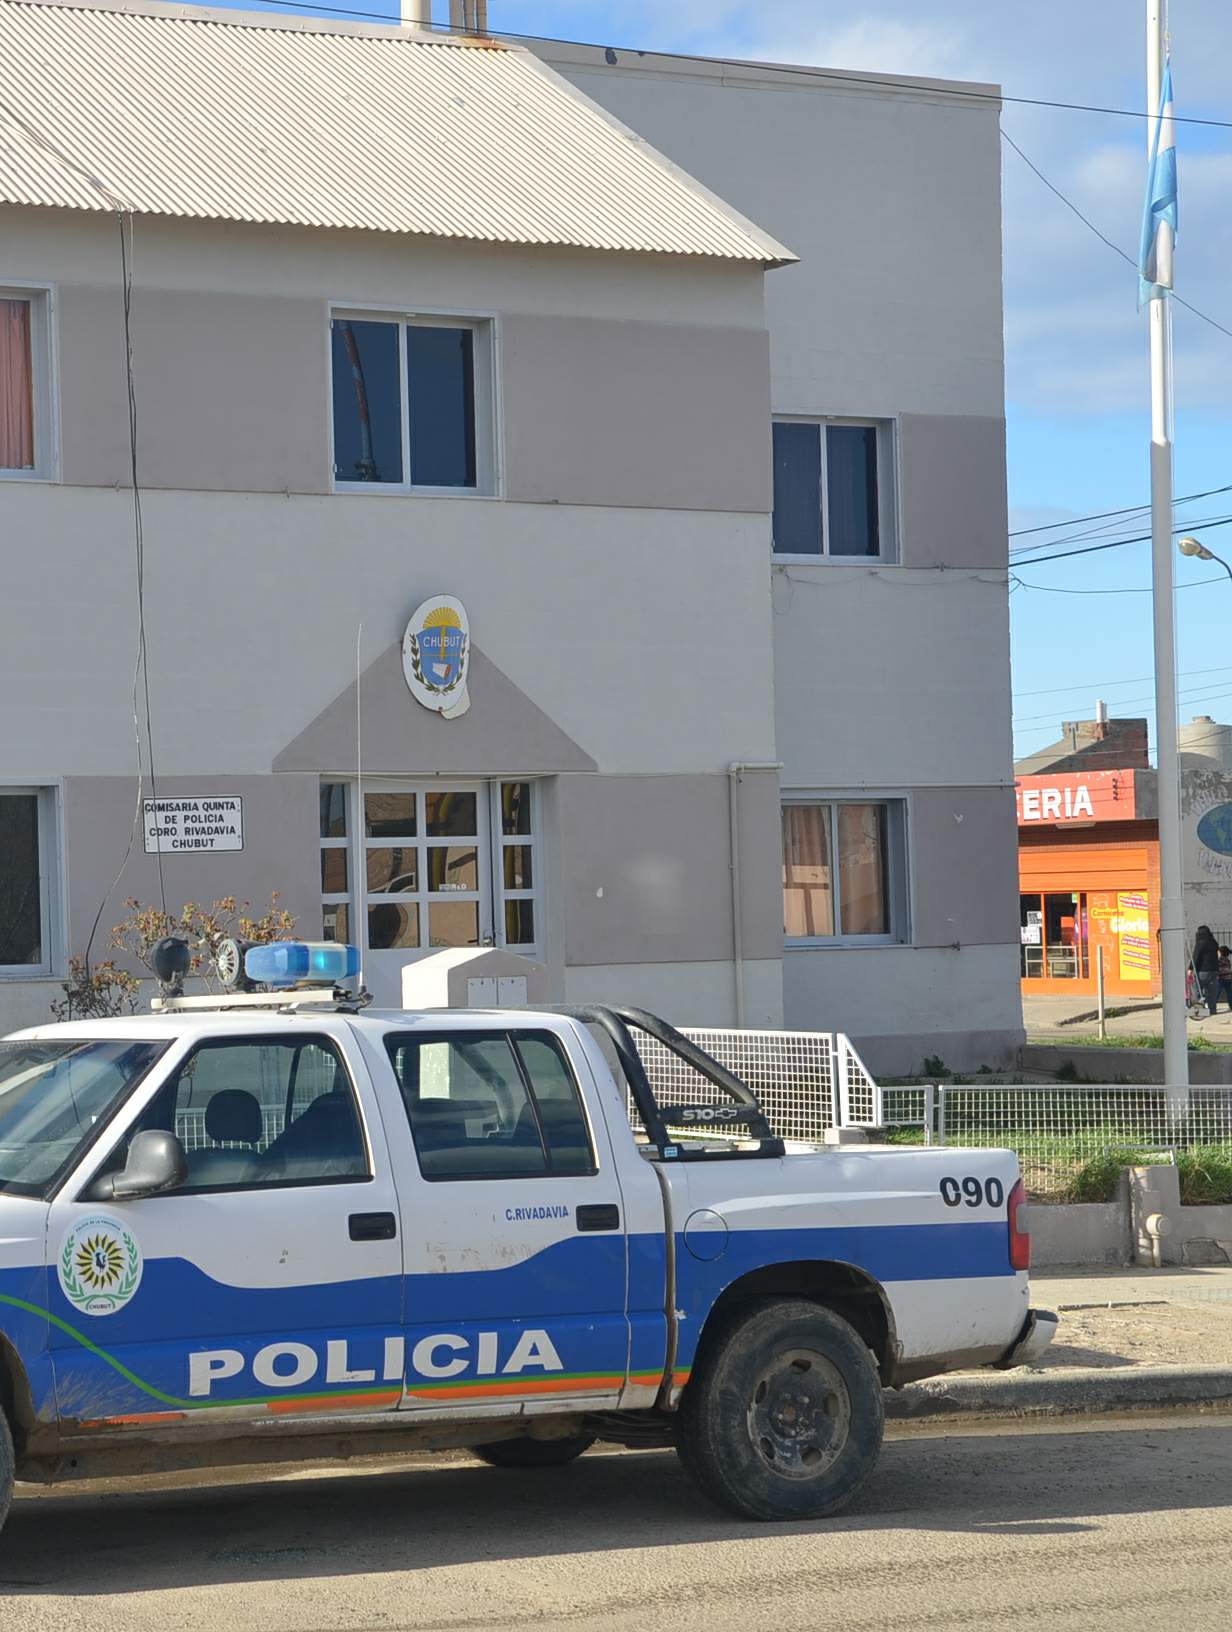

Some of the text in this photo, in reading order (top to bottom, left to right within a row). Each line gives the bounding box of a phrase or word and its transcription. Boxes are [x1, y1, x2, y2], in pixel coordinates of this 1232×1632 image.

[423, 636, 460, 648] CHUBUT
[144, 801, 236, 812] COMISARIA QUINTA
[1016, 785, 1094, 820] ERIA
[164, 814, 225, 824] DE POLICIA
[149, 826, 236, 837] CDRO RIVADAVIA
[171, 838, 215, 849] CHUBUT
[682, 1108, 715, 1121] S10
[505, 1206, 569, 1221] C.RIVADAVIA
[188, 1329, 565, 1397] POLICIA
